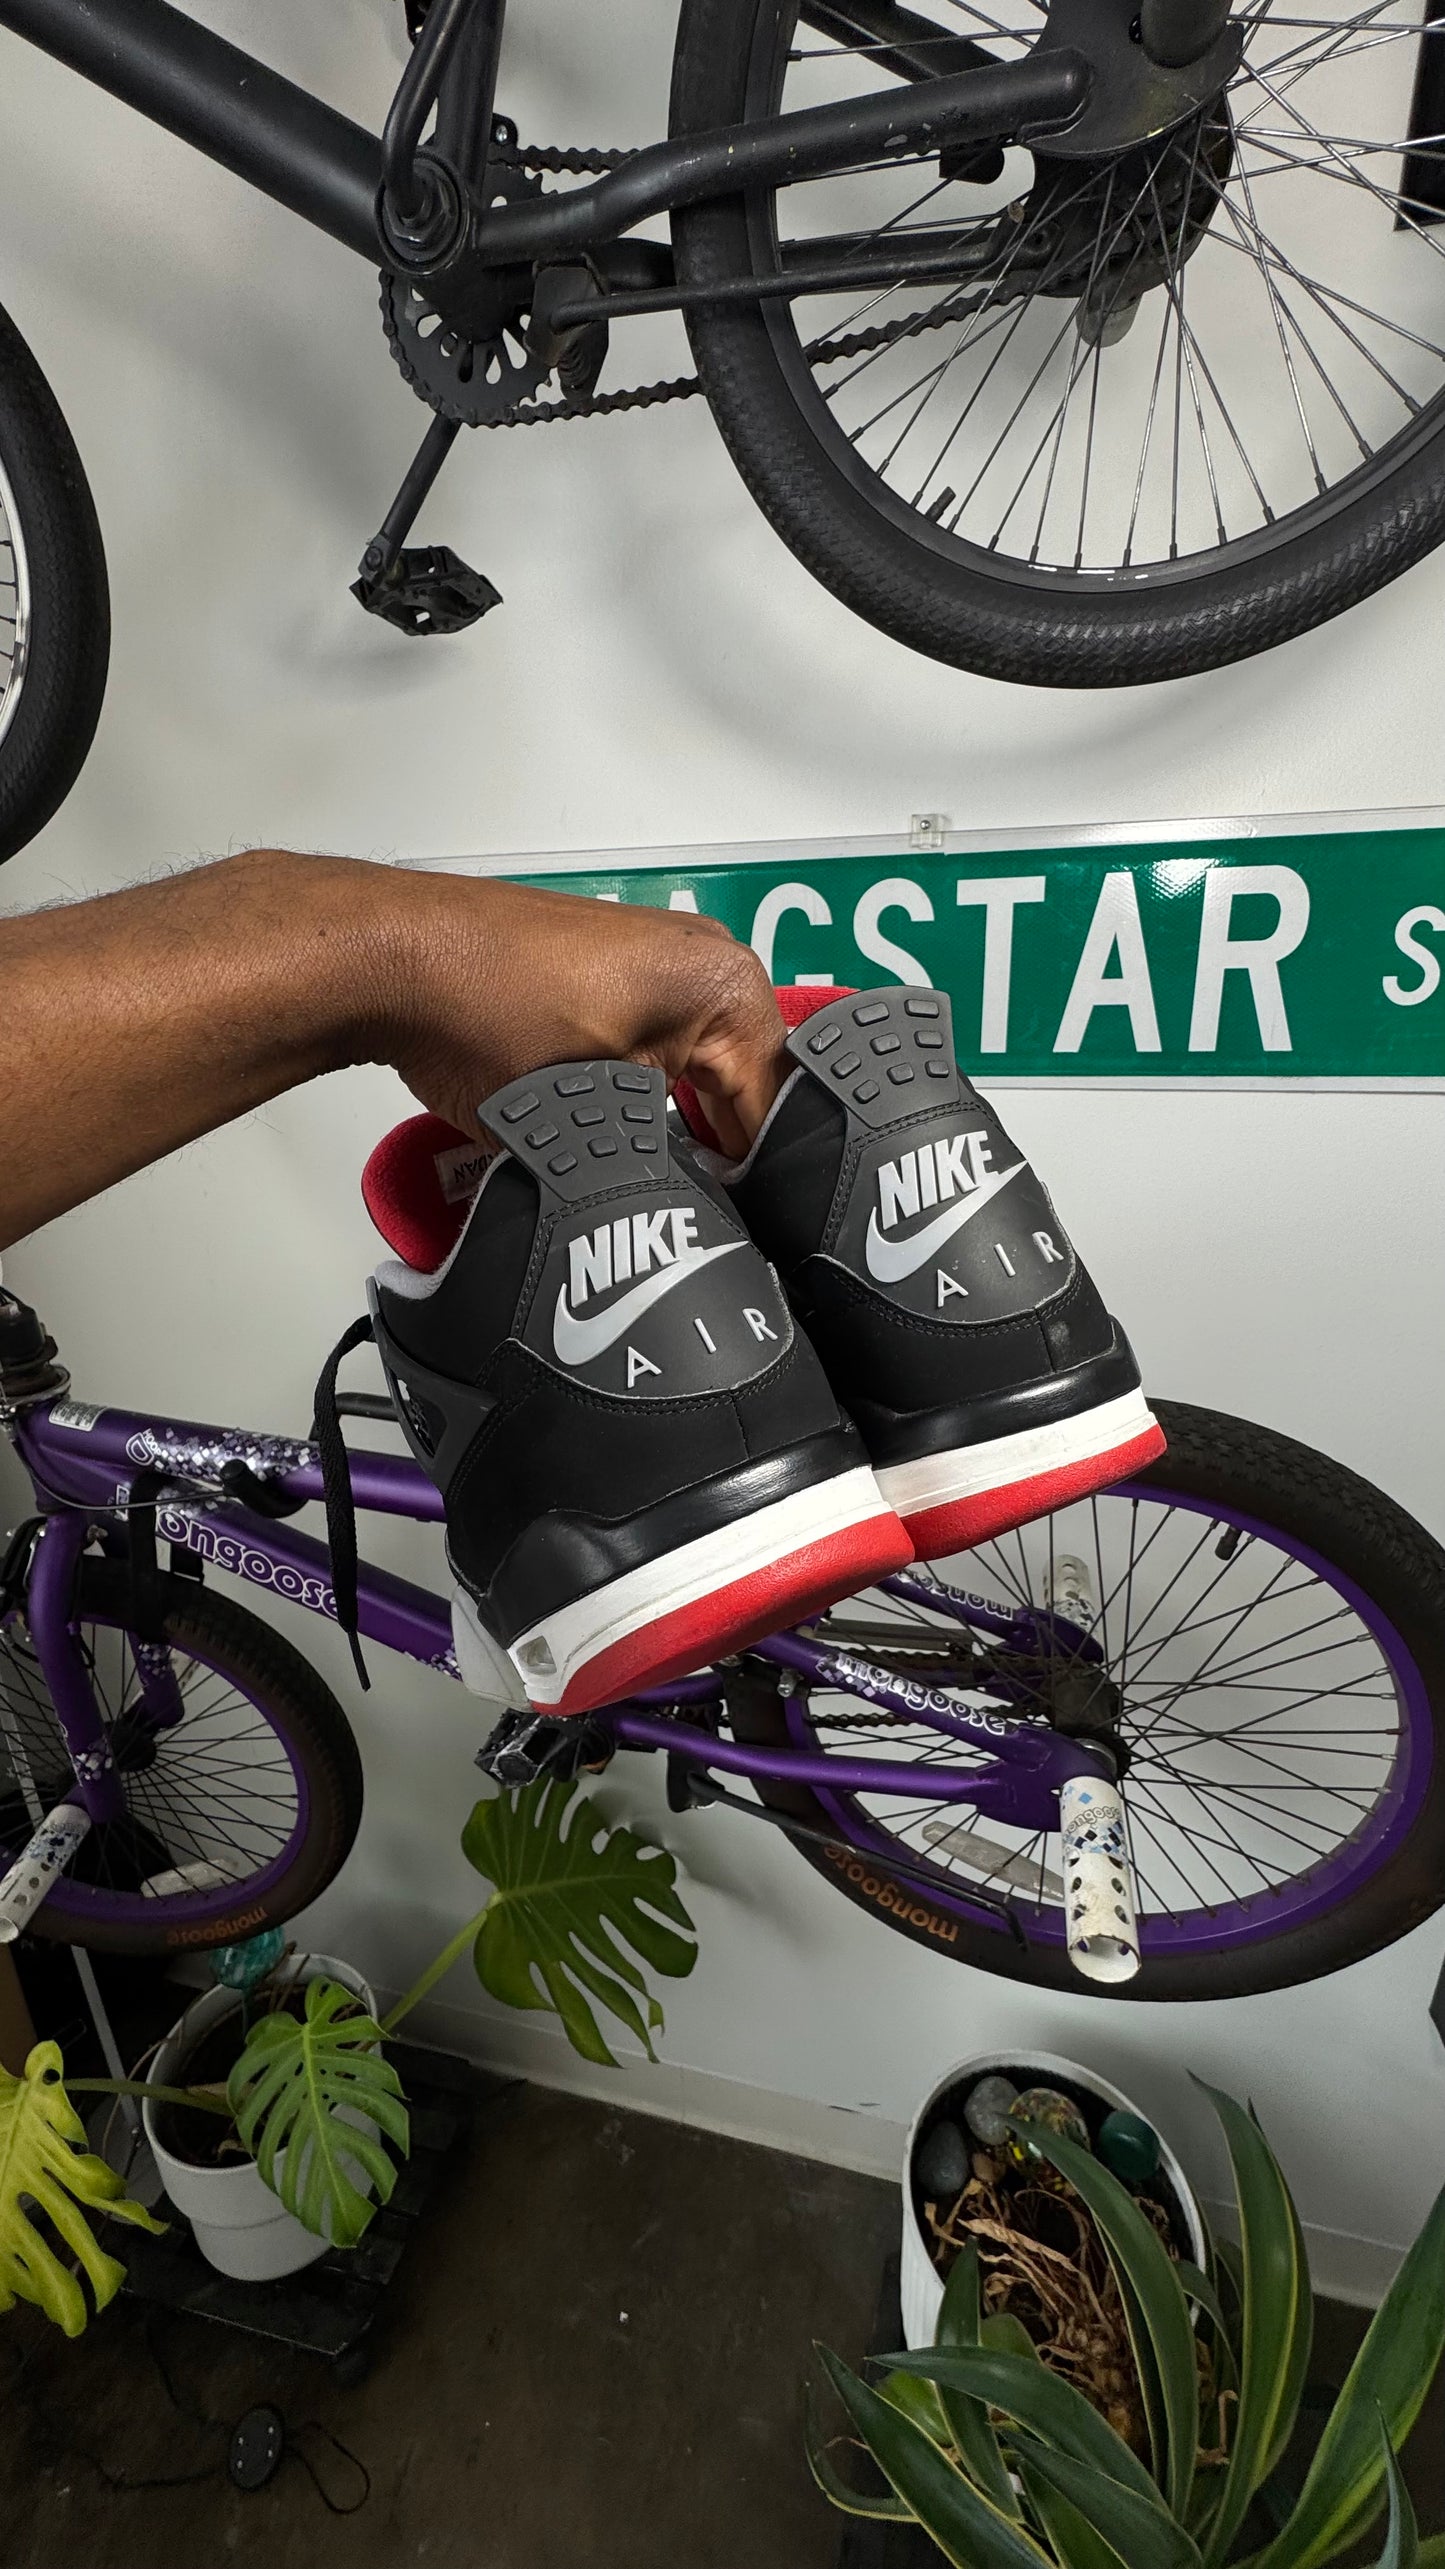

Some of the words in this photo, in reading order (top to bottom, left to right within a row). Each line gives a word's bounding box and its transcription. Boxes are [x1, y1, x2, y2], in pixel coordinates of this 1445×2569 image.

[596, 864, 1311, 1054] GSTAR
[1382, 905, 1445, 1006] S
[876, 1128, 996, 1230] NIKE
[567, 1206, 699, 1308] NIKE
[935, 1231, 1064, 1308] AIR
[626, 1307, 778, 1389] AIR
[116, 1484, 339, 1620] ongoose
[836, 1652, 1006, 1736] mongoose
[167, 1906, 268, 1944] mongoose
[824, 1847, 959, 1942] mongoose
